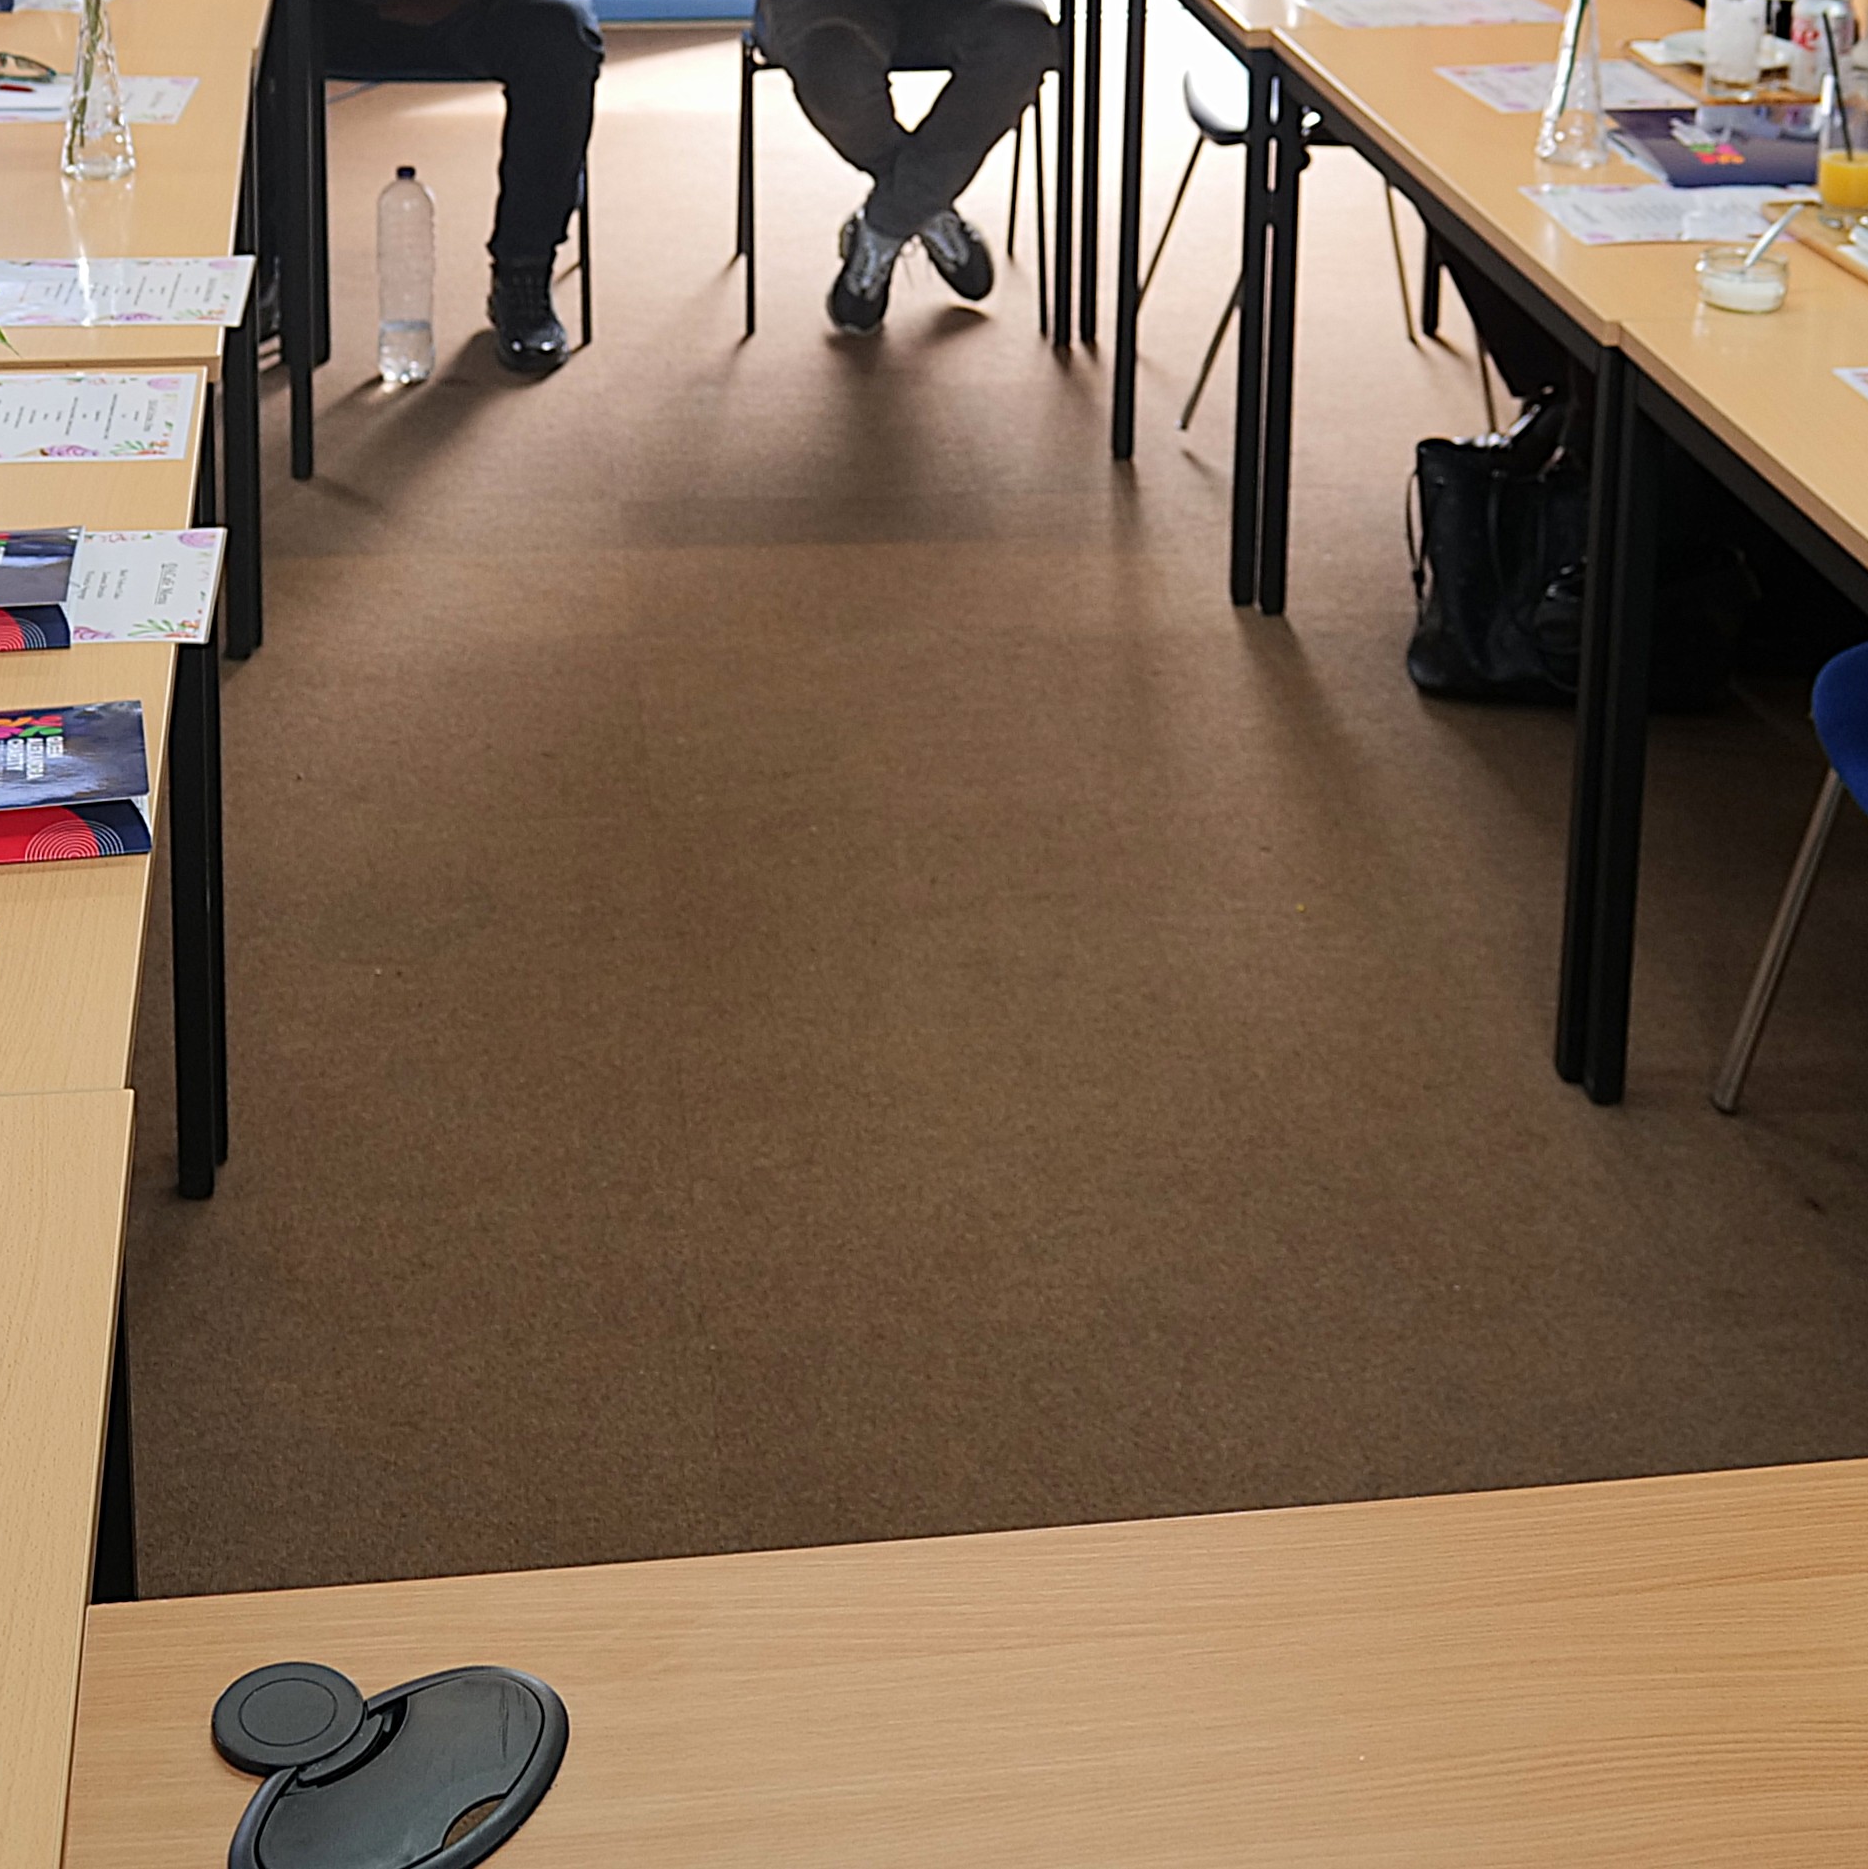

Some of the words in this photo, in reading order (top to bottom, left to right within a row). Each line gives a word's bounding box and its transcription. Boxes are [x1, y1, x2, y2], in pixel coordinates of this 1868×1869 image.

[6, 738, 24, 771] CHARITY
[26, 738, 44, 781] ALEXANDRA
[46, 736, 64, 759] QUEEN
